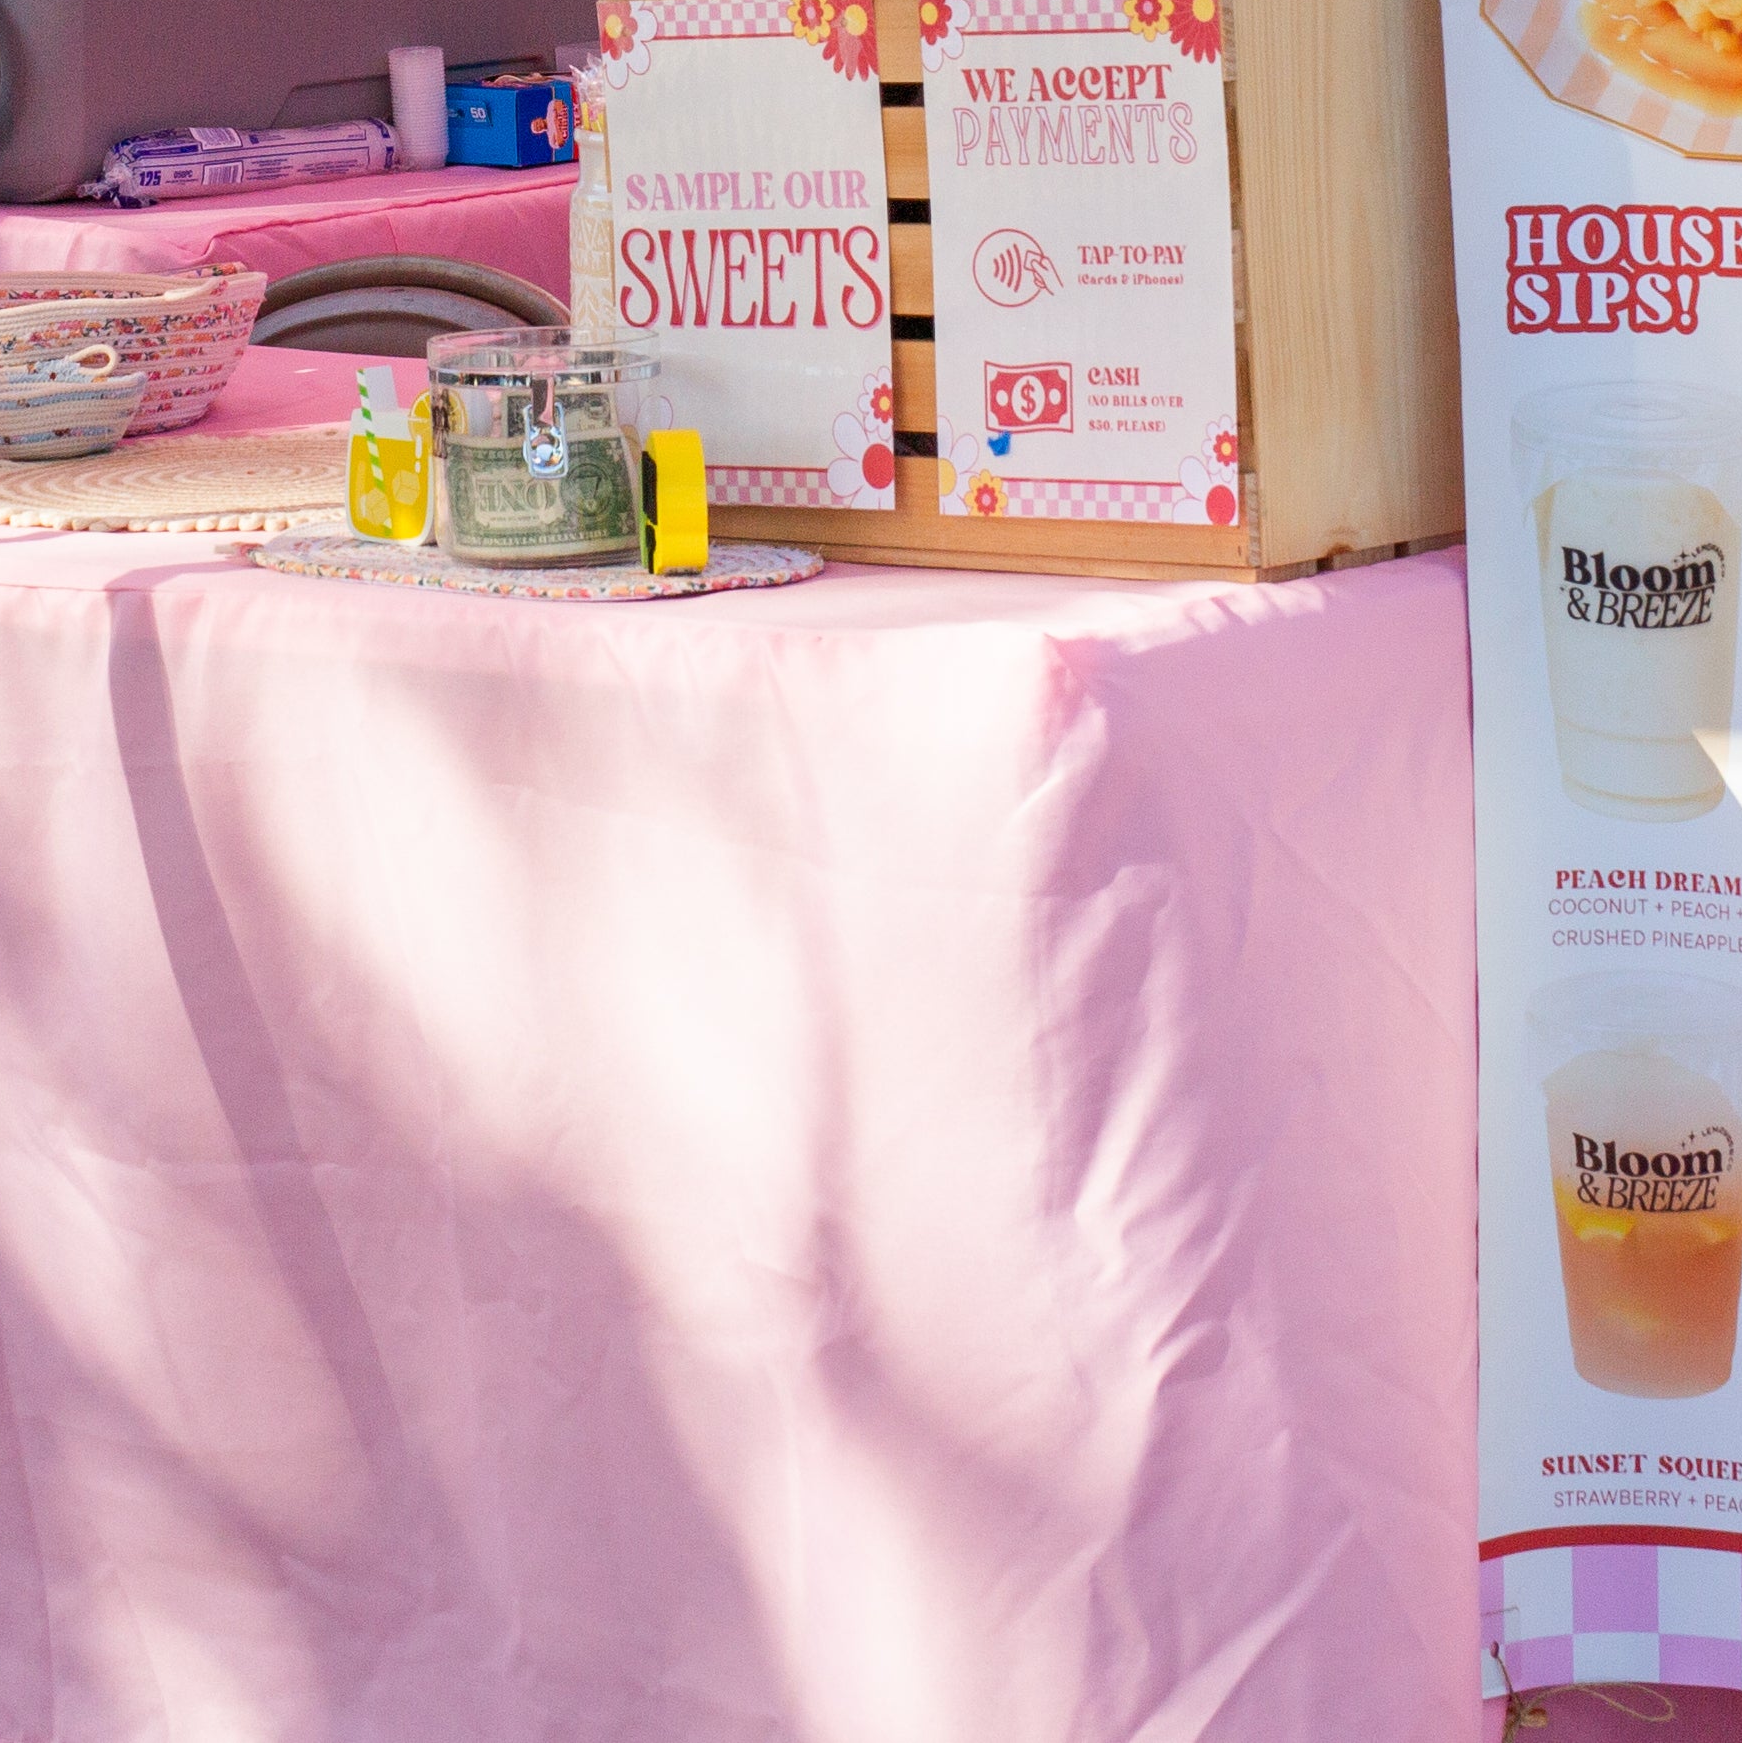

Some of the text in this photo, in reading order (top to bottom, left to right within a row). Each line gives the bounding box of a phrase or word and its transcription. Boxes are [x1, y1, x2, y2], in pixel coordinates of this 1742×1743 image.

[961, 63, 1173, 103] WE ACCEPT
[953, 101, 1198, 167] PAYMENTS
[139, 170, 162, 186] 125
[625, 170, 871, 212] SAMPLE OUR
[1077, 245, 1187, 265] TAP-TO-PAY
[619, 225, 886, 330] SWEETS
[1077, 273, 1118, 285] (Cards
[1133, 273, 1184, 286] iPhones)
[1506, 268, 1701, 335] SIPS!
[1087, 367, 1140, 387] CASH
[1088, 394, 1184, 408] (NO BILLS OVER
[1117, 419, 1166, 433] PLEASE)
[1562, 546, 1716, 593] Bloom
[1567, 585, 1716, 629] & BREEZE
[1555, 869, 1742, 897] PEACH DREAM
[1548, 897, 1649, 915] COCONUT
[1671, 900, 1731, 920] PEACH
[1552, 929, 1646, 946] CRUSHED
[1572, 1132, 1723, 1178] Bloom
[1577, 1172, 1720, 1213] & BREEZE
[1542, 1453, 1648, 1476] SUNSET
[1554, 1489, 1682, 1508] STRAWBERRY
